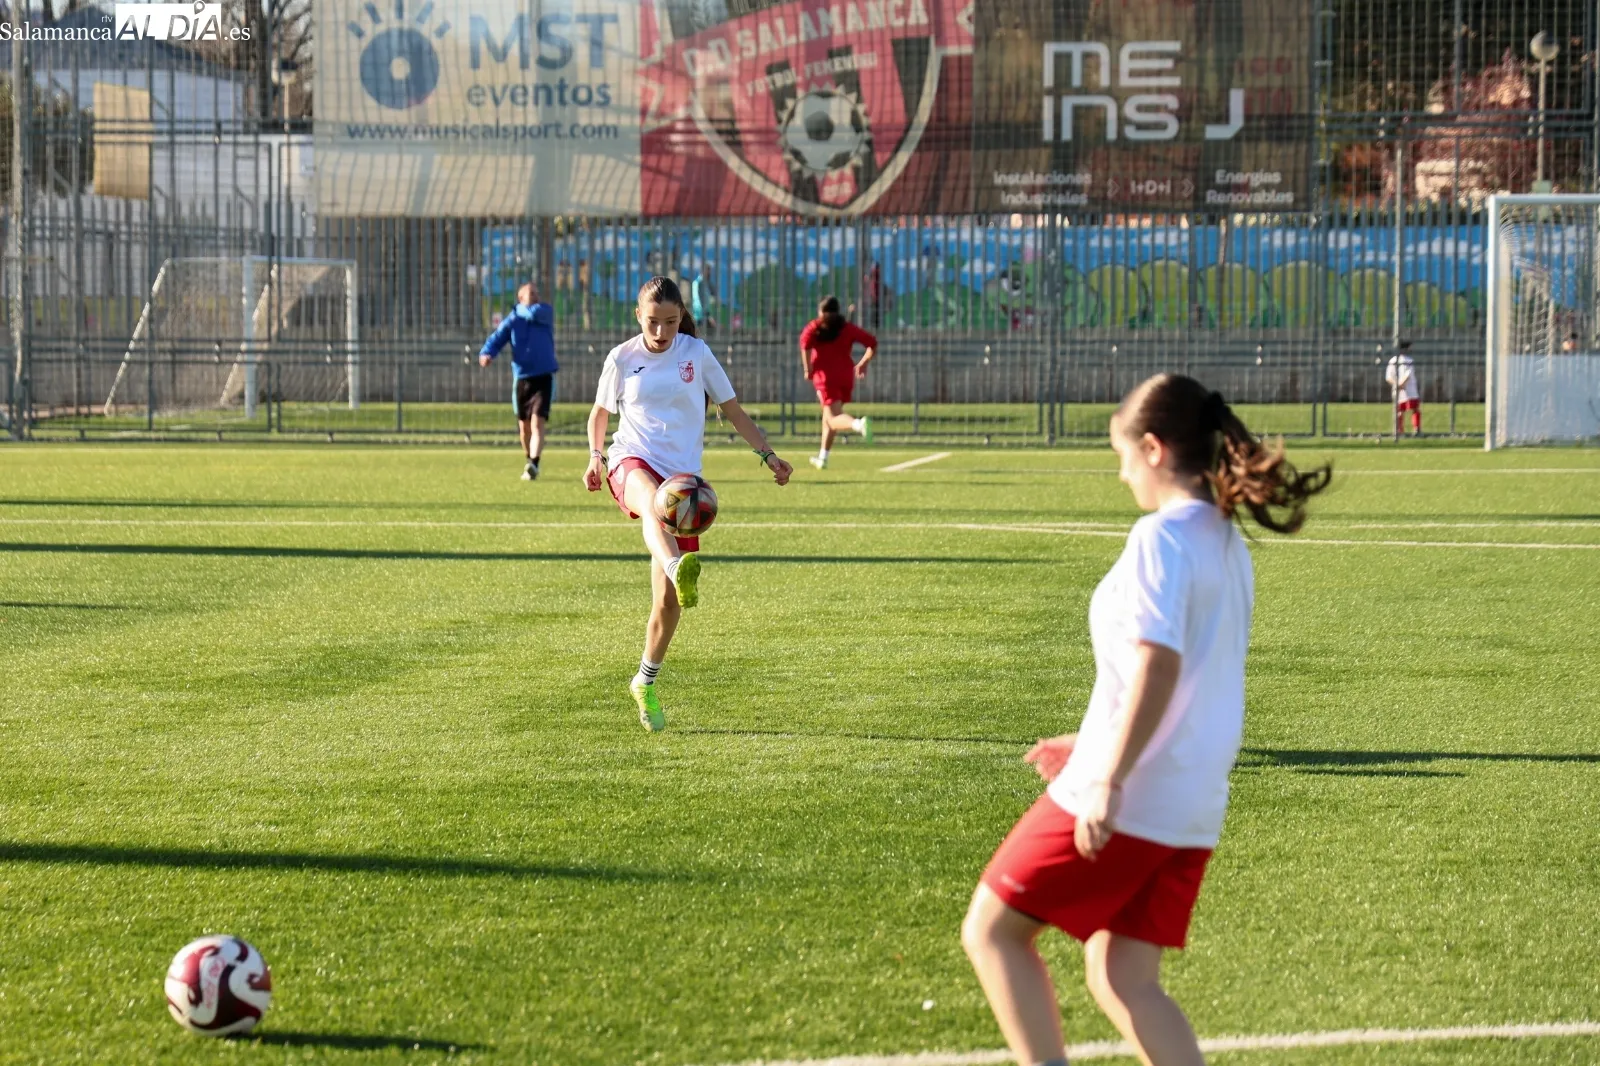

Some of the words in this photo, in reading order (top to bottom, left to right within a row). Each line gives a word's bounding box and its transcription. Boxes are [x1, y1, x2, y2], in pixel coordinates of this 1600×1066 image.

[468, 12, 619, 70] MST
[467, 77, 612, 108] eventos
[346, 117, 620, 143] www.musicalsport.com
[993, 170, 1093, 186] Instalaciones
[1000, 189, 1088, 205] Industriales
[1206, 189, 1294, 204] Renovables
